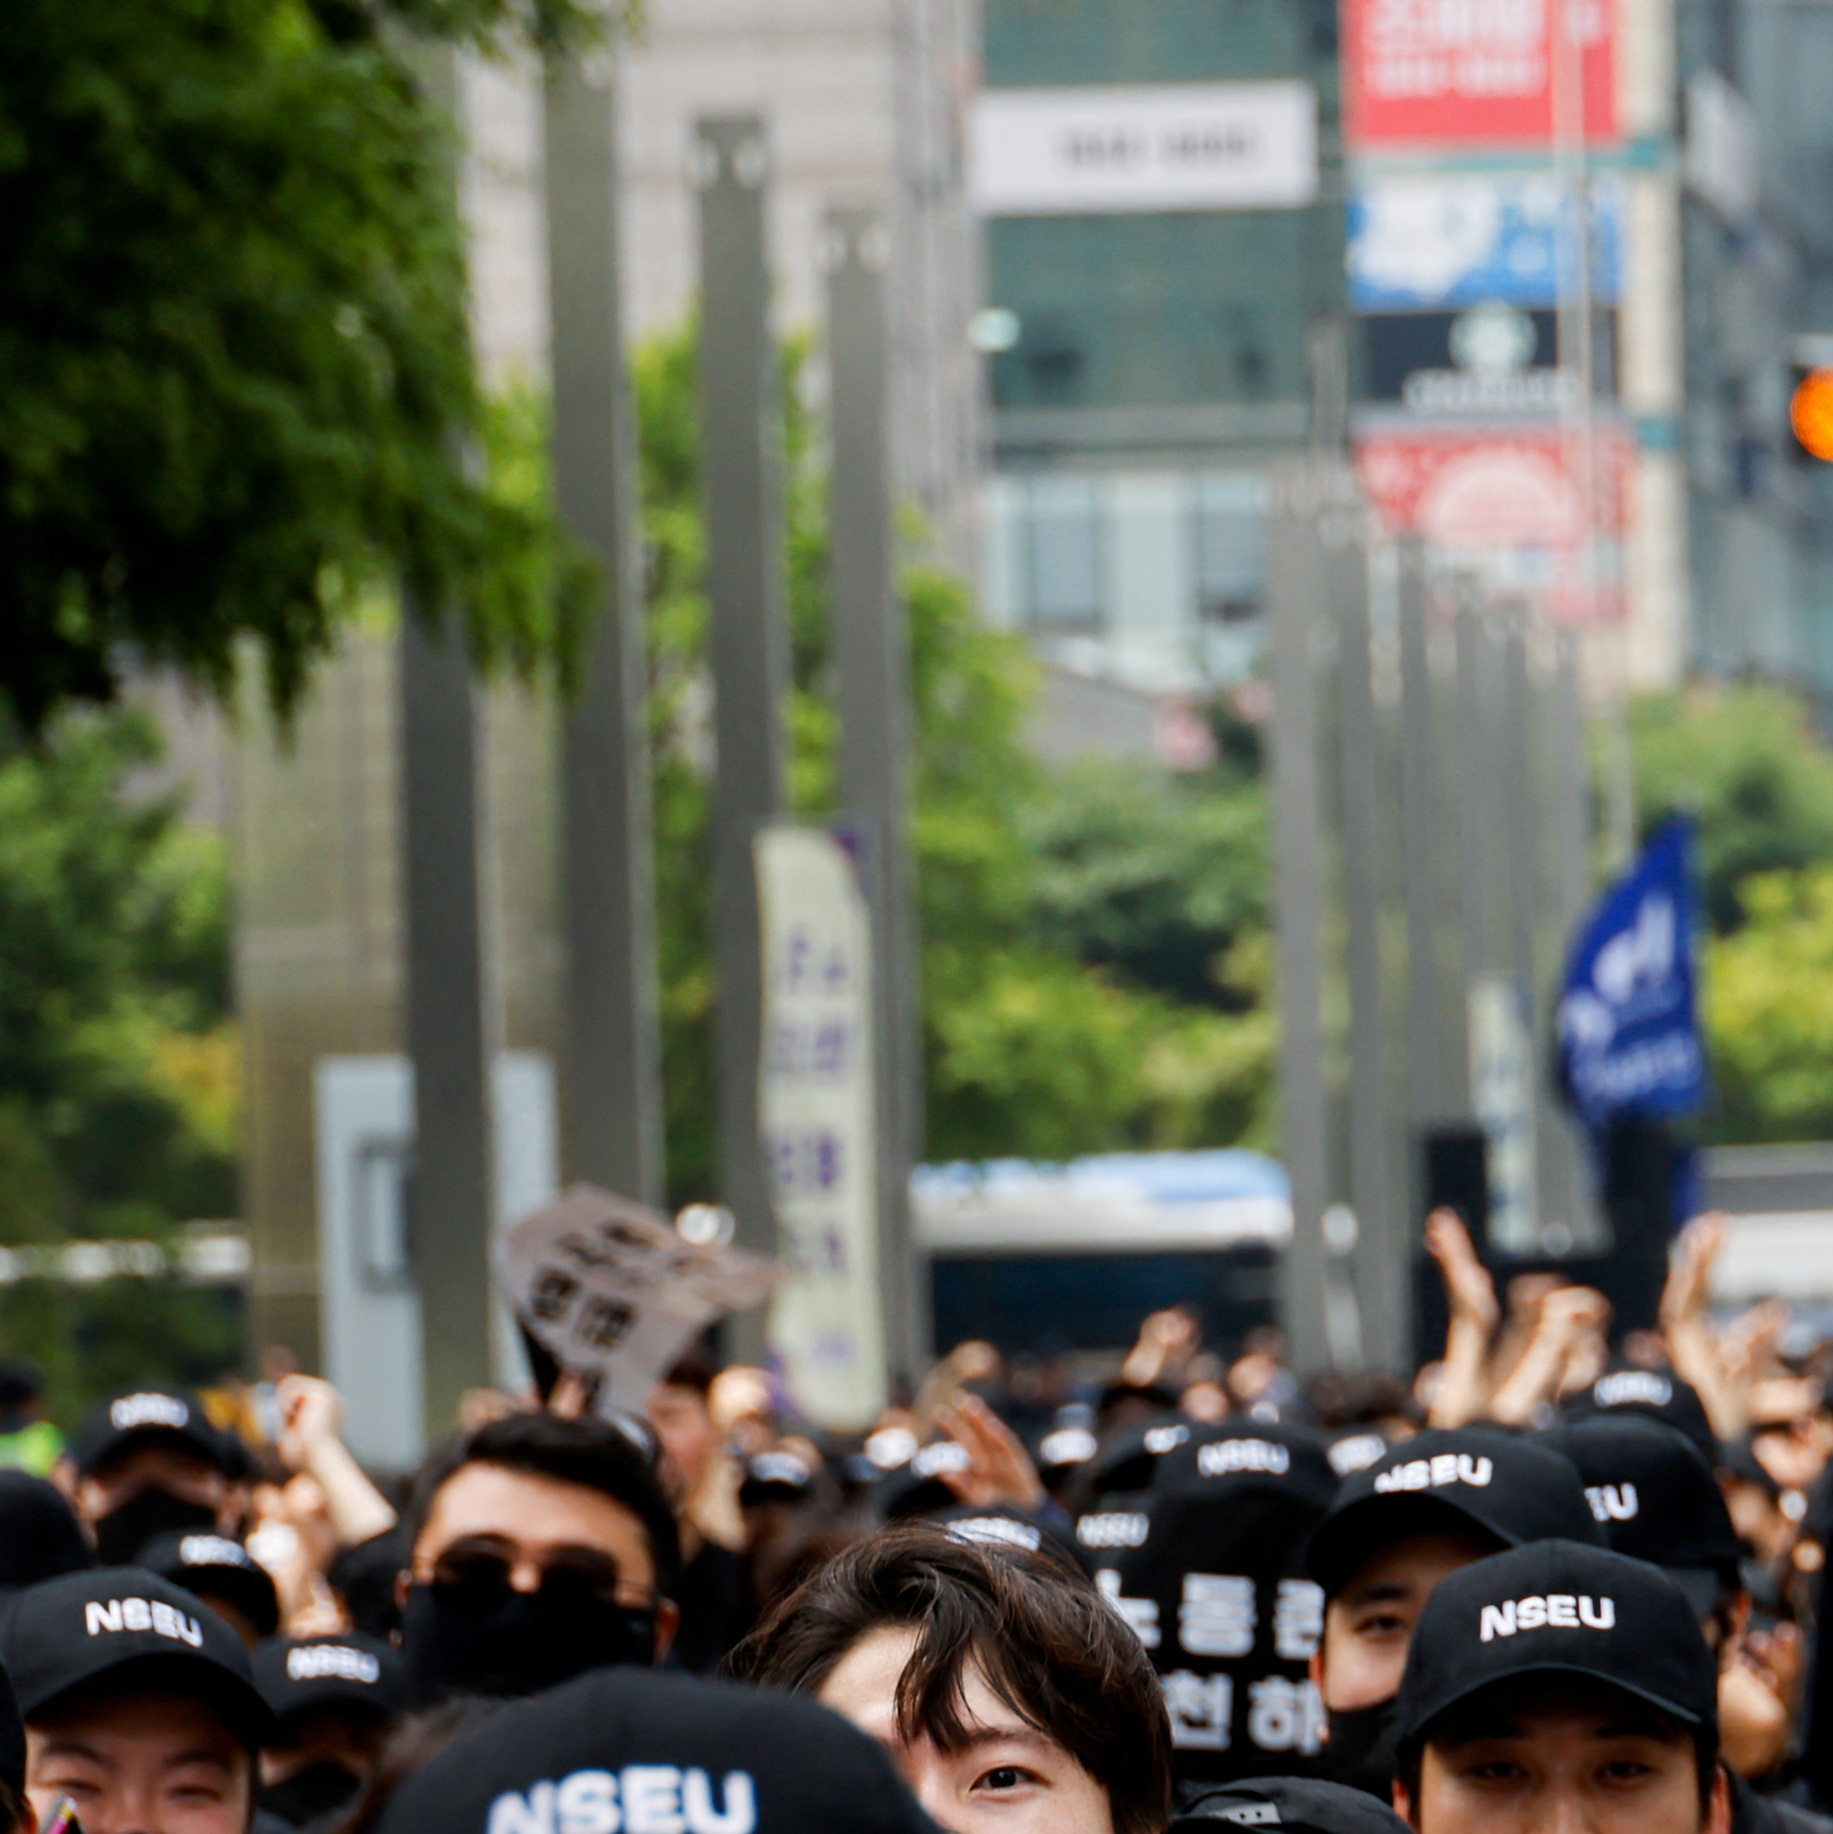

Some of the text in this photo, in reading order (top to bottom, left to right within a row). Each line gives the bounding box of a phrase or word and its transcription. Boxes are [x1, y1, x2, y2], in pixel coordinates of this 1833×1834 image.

[1374, 1453, 1494, 1494] NSEU
[85, 1597, 203, 1647] NSEU
[1480, 1594, 1616, 1642] NSEU
